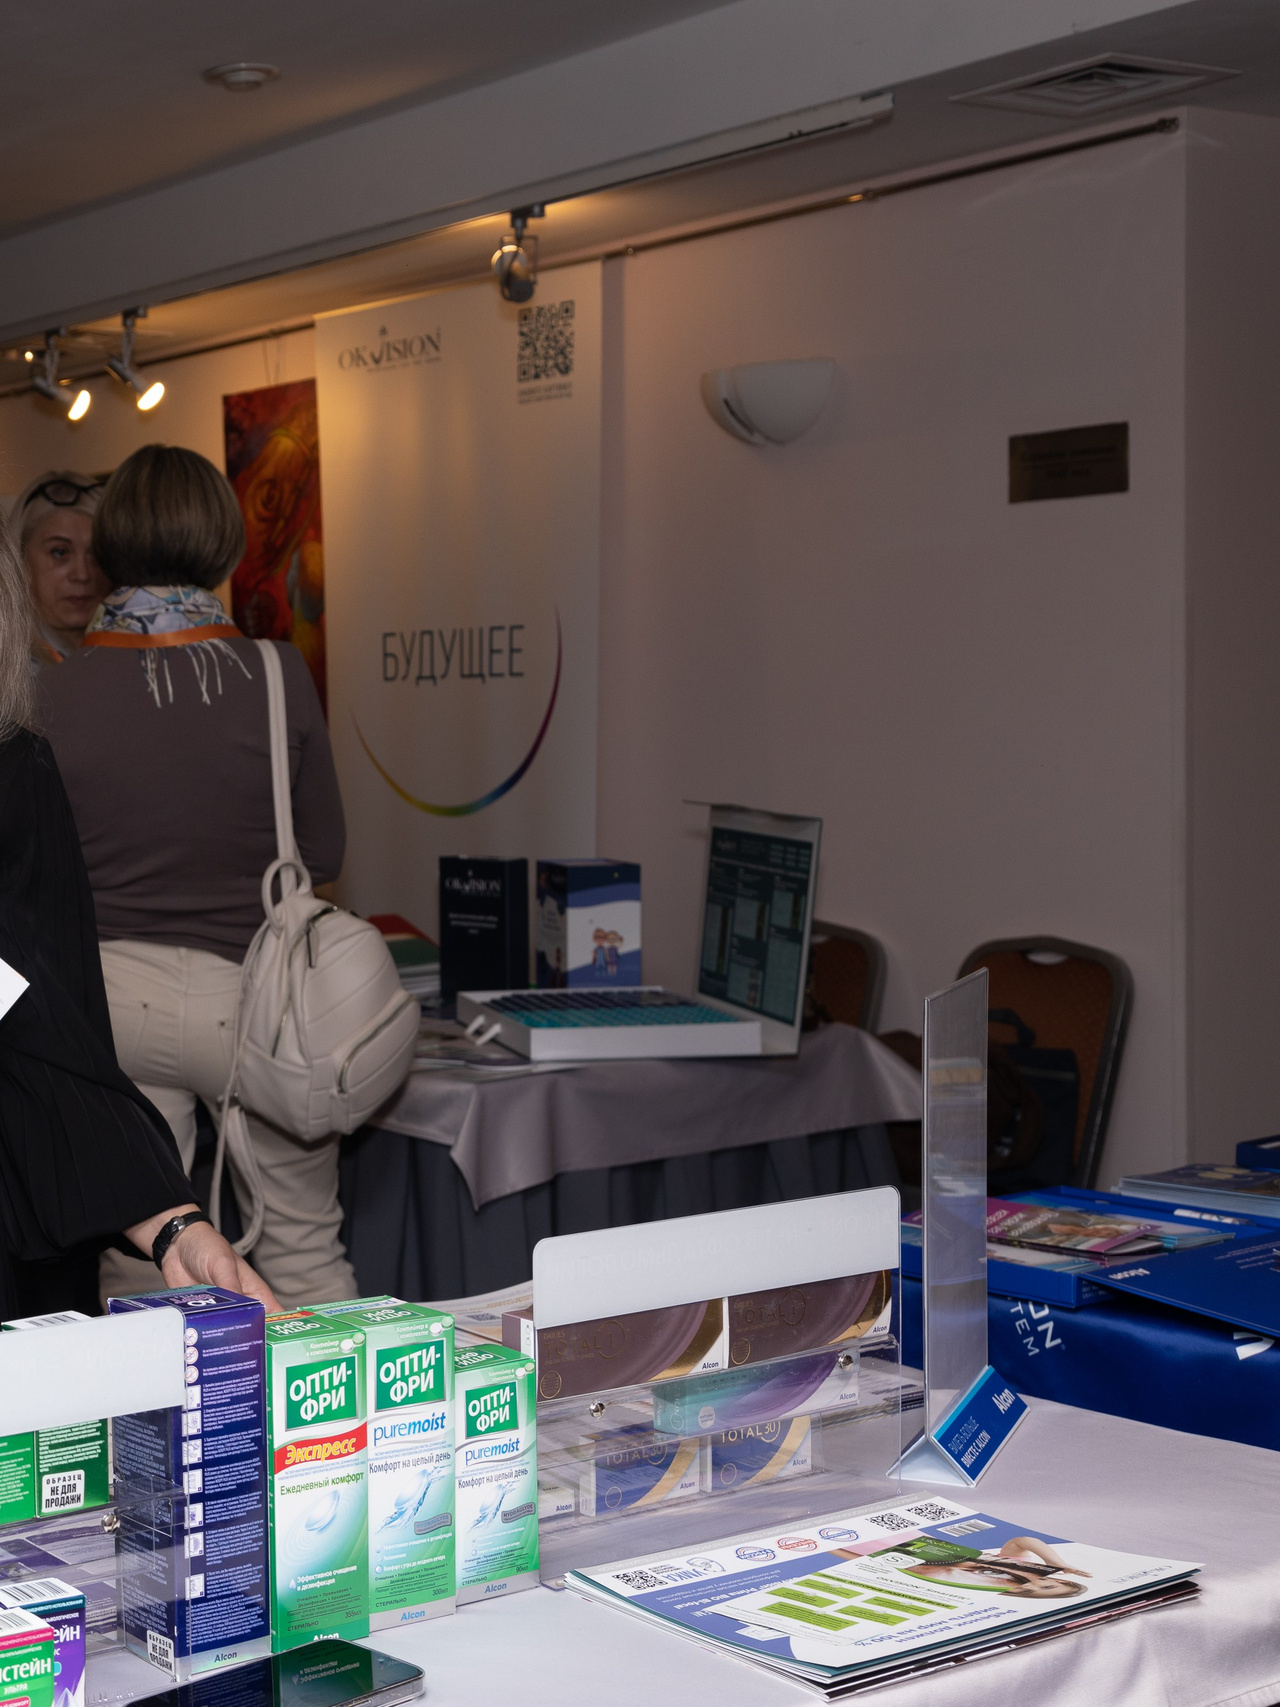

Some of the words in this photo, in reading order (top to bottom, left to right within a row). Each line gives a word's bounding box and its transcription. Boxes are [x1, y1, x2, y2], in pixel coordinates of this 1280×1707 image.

[382, 624, 525, 686] БУДУЩЕЕ
[396, 1325, 423, 1334] Контейнер
[400, 1330, 429, 1339] комплекте
[543, 1330, 566, 1340] DAILIES
[873, 1325, 888, 1333] Alcon
[1010, 1301, 1040, 1356] TEM
[309, 1340, 339, 1350] Контейнер
[379, 1345, 441, 1384] ОПТИ-
[702, 1361, 719, 1370] Alcon
[289, 1362, 352, 1401] ОПТИ-
[389, 1369, 434, 1403] ФРИ
[468, 1386, 514, 1417] ОПТИ-
[839, 1391, 856, 1401] Alcon
[991, 1388, 1016, 1414] Alcon
[300, 1386, 346, 1421] ФРИ
[476, 1404, 510, 1432] ФРИ
[373, 1412, 446, 1447] puremoist
[285, 1438, 356, 1465] Экспресс
[465, 1438, 520, 1466] puremoist
[369, 1461, 400, 1474] Комфорт
[402, 1458, 411, 1468] на
[412, 1453, 434, 1467] целый
[435, 1451, 451, 1463] день
[792, 1458, 808, 1467] Alcon
[46, 1474, 82, 1485] ОБРАЗЕЦ
[280, 1477, 330, 1495] Ежедневный
[331, 1472, 364, 1485] комфорт
[458, 1477, 485, 1489] Комфорт
[486, 1475, 493, 1483] на
[493, 1469, 513, 1483] целый
[514, 1468, 528, 1477] день
[50, 1486, 59, 1496] НЕ
[61, 1483, 77, 1495] ДЛЯ
[680, 1481, 696, 1490] Alcon
[45, 1494, 81, 1509] ПРОДАЖИ
[556, 1504, 573, 1512] Alcon
[297, 1571, 332, 1583] Эффективное
[333, 1565, 357, 1575] очищение
[662, 1568, 705, 1582] УМКА
[301, 1578, 336, 1591] дезинфекция
[462, 1576, 487, 1586] СТЕРИЛЬНО
[485, 1583, 507, 1593] Alcon
[728, 1586, 758, 1597] Prima
[375, 1597, 407, 1608] СТЕРИЛЬНО
[673, 1598, 710, 1610] Bi-focal
[710, 1593, 726, 1602] BIO
[401, 1610, 425, 1621] Alcon
[948, 1606, 999, 1623] видеть
[956, 1609, 1018, 1626] Ребенок
[288, 1621, 319, 1632] СТЕРИЛЬНО
[917, 1620, 947, 1630] мир
[894, 1625, 952, 1643] должен
[895, 1628, 916, 1637] на
[151, 1643, 158, 1654] НЕ
[158, 1646, 169, 1659] ДЛЯ
[214, 1651, 238, 1662] Alcon
[149, 1652, 173, 1672] ПРОДАЖИ
[3, 1683, 28, 1695] УЛЬТРА
